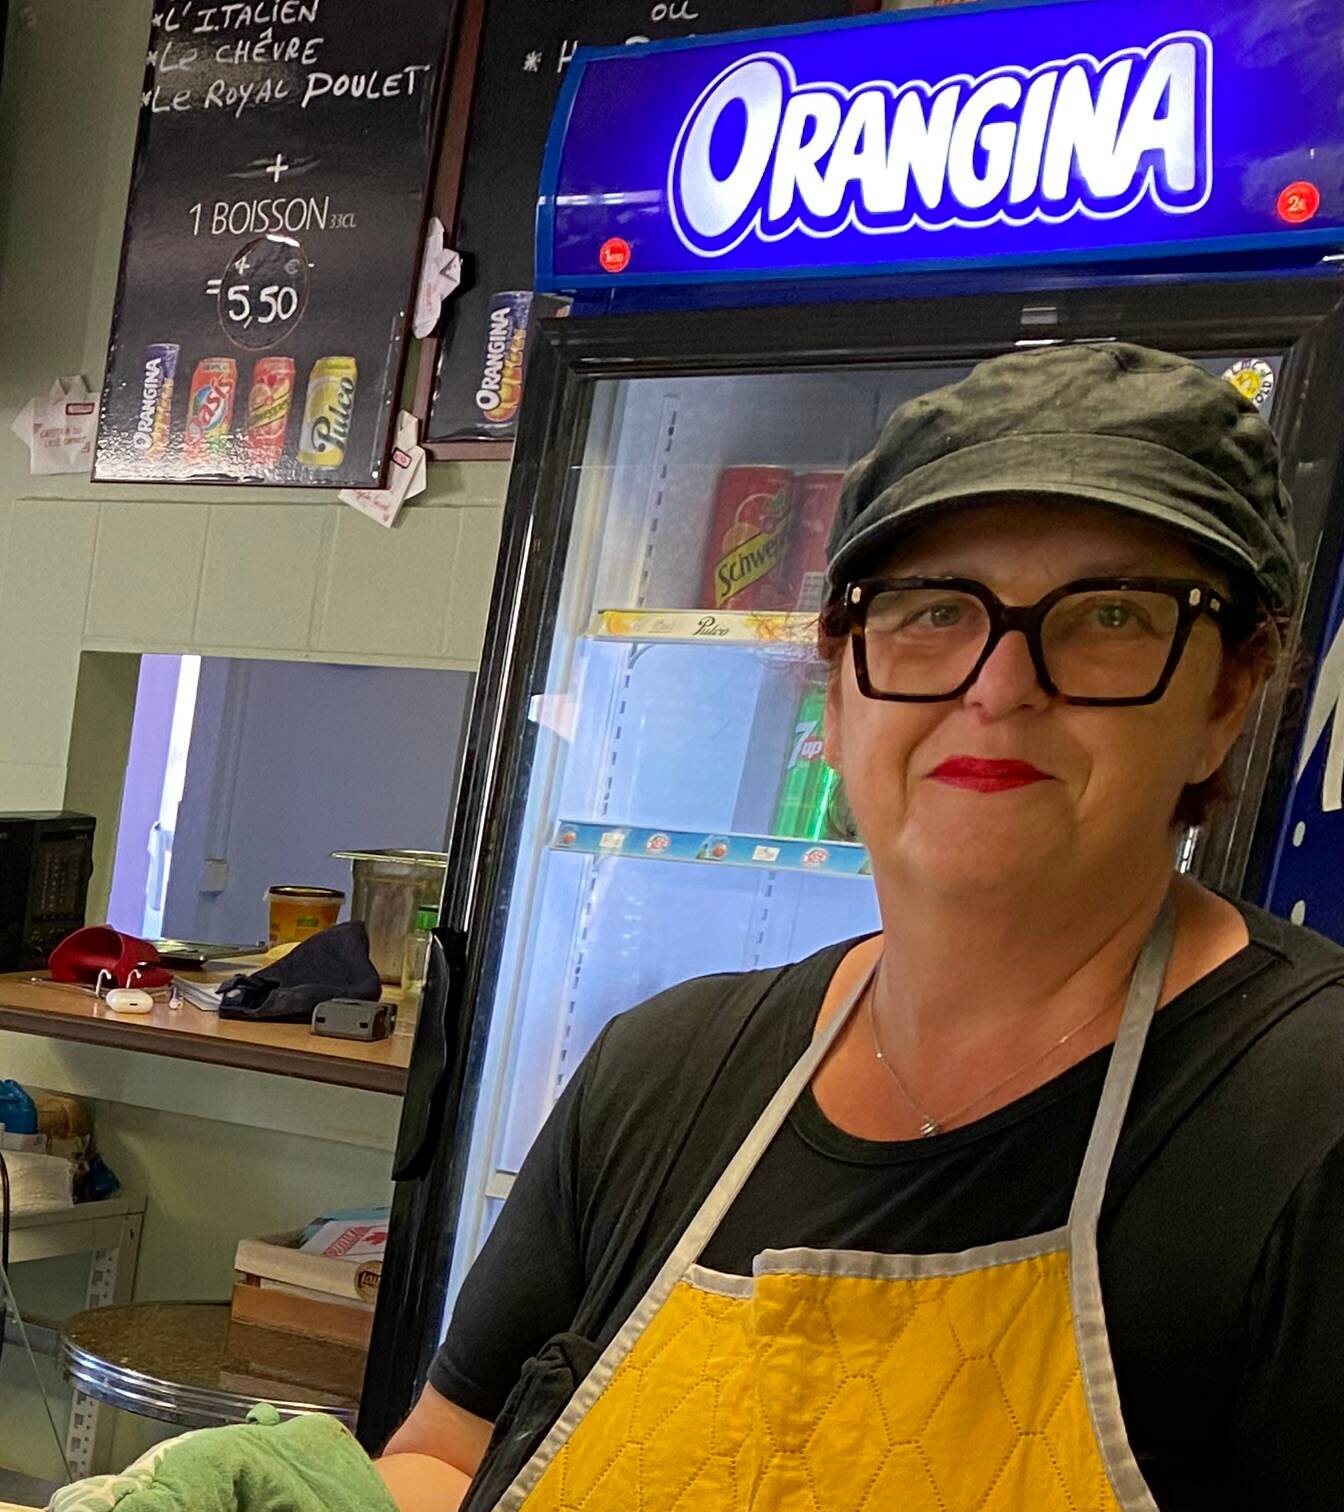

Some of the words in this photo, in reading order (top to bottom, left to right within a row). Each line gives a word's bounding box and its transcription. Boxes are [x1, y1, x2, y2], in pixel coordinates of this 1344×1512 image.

[204, 79, 289, 118] ROYAL
[301, 64, 431, 108] POULET
[678, 38, 1204, 240] ORANGINA
[189, 203, 201, 236] 1
[211, 196, 329, 235] BOISSON
[228, 284, 298, 329] 5,50
[476, 307, 511, 411] ORANGINA
[133, 357, 163, 449] ORANGINA
[312, 377, 354, 453] Pulco
